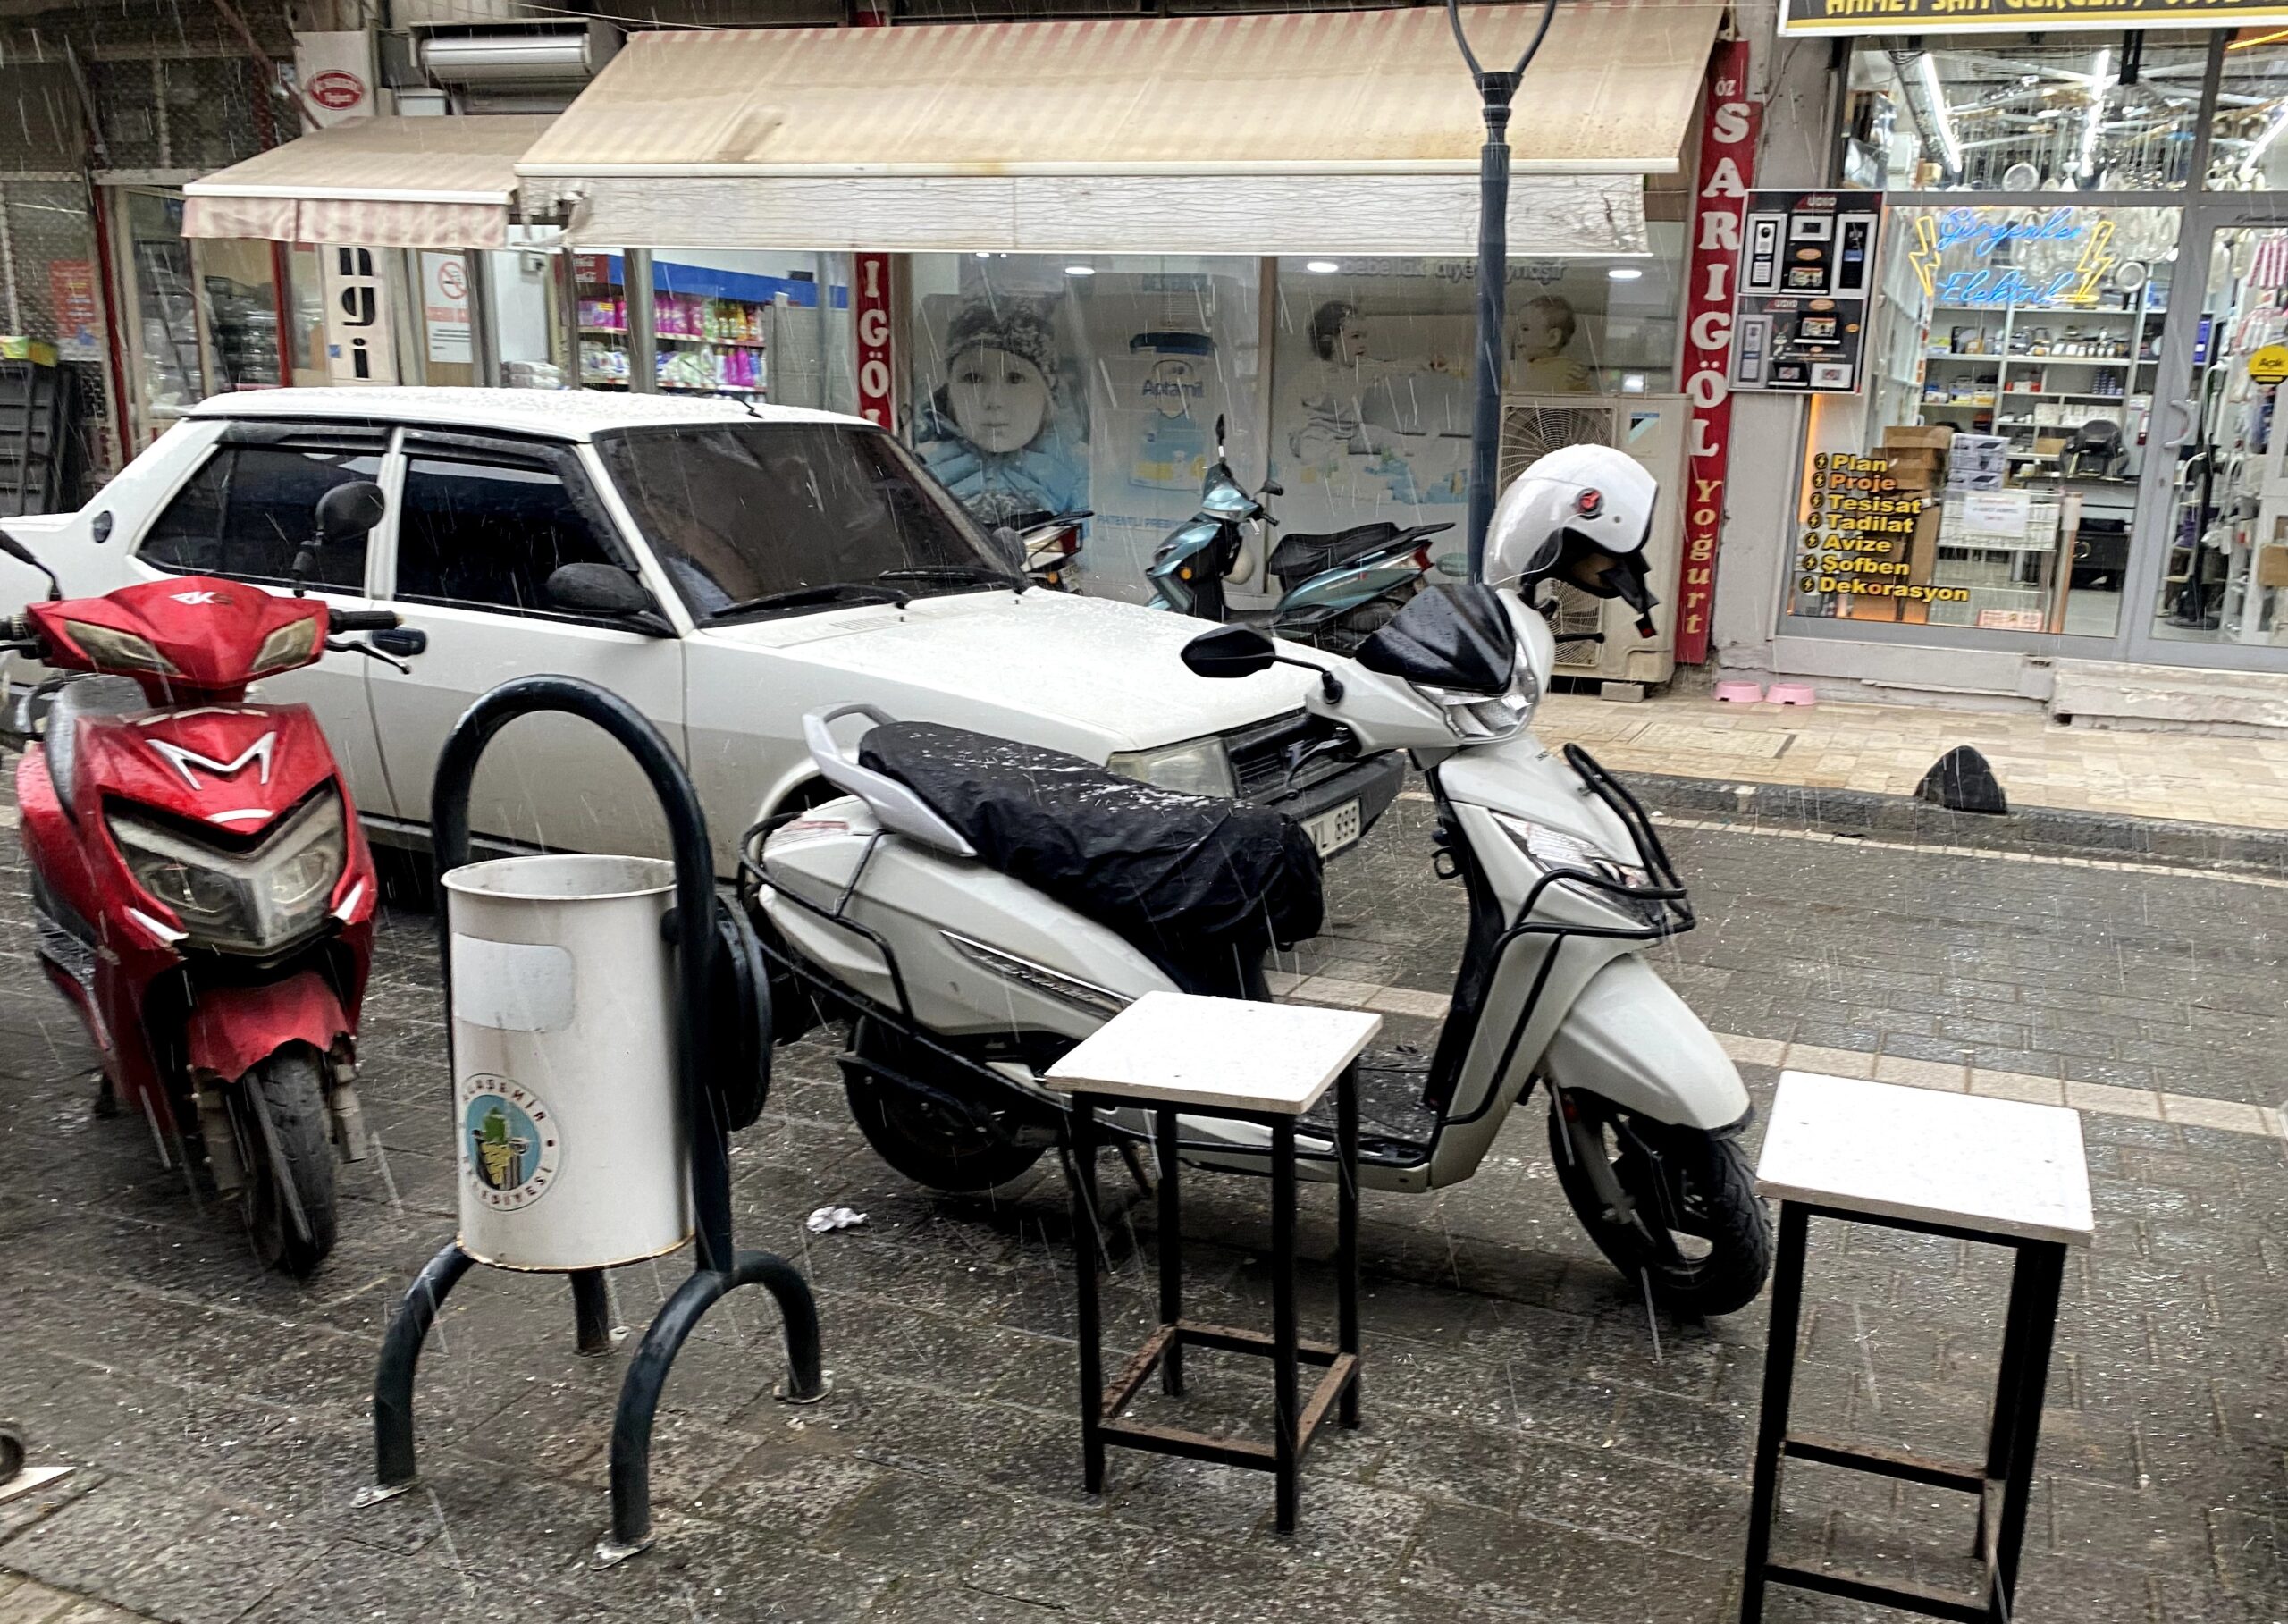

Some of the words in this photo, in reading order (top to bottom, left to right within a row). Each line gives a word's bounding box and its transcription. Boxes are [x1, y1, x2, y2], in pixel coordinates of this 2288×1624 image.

[1686, 102, 1752, 457] SARIGÖL
[1142, 379, 1203, 399] Aptamil
[1831, 452, 1888, 472] Plan
[1829, 472, 1897, 493] Proje
[1827, 492, 1922, 514] Tesisat
[1826, 513, 1915, 534] Tadilat
[1821, 533, 1893, 553] Avize
[1686, 479, 1723, 634] Yoğurt
[1821, 554, 1911, 576] Şofben
[1818, 576, 1970, 602] Dekorasyon
